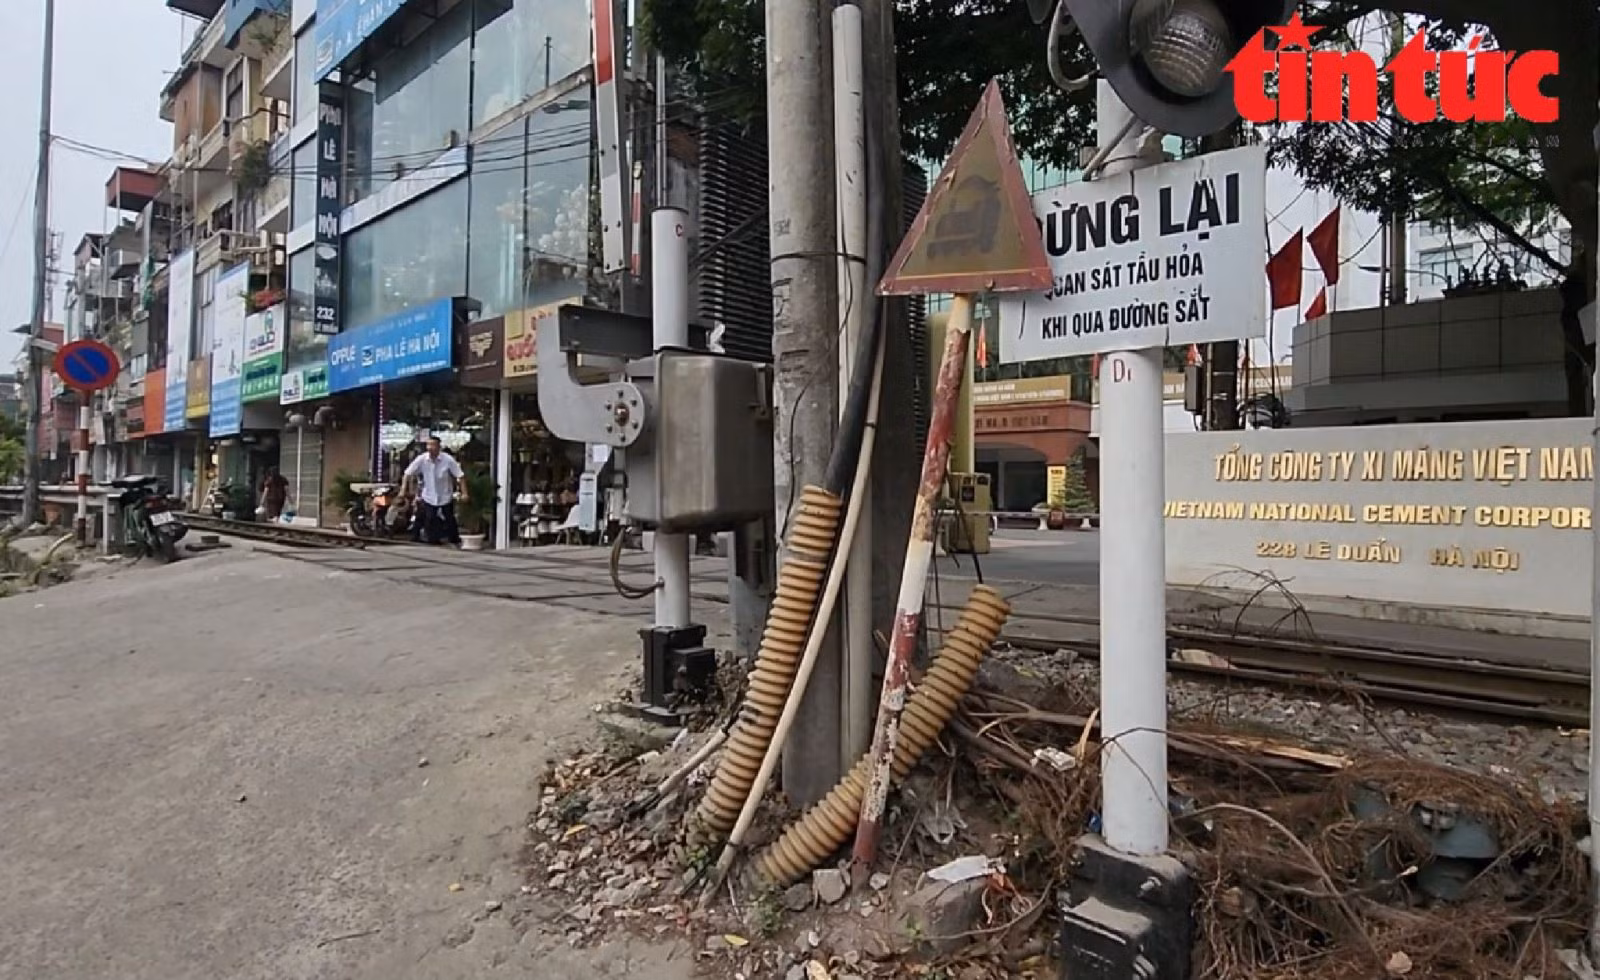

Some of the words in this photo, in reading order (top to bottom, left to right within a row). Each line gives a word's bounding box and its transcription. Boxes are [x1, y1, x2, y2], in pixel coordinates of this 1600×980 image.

[324, 138, 337, 161] LÊ
[1034, 194, 1139, 257] ỪNG
[1160, 173, 1239, 240] LẠI
[1045, 270, 1086, 301] UAN
[1091, 261, 1122, 291] SÁT
[1166, 243, 1203, 279] HỎA
[317, 306, 334, 320] 232
[1042, 315, 1068, 340] KHI
[1072, 310, 1104, 338] QUA
[1109, 297, 1168, 331] ĐƯỜNG
[1175, 285, 1210, 323] SẮT
[394, 336, 406, 358] LÊ
[1215, 443, 1263, 481] TỔNG
[1269, 448, 1322, 481] CÔNG
[1328, 452, 1355, 481] TY
[1361, 450, 1385, 481] XI
[1472, 445, 1531, 487] VIỆT
[1249, 502, 1356, 523] NATIONAL
[1362, 504, 1467, 526] CEMENT
[1256, 541, 1297, 558] 228
[1303, 540, 1331, 560] LÊ
[1429, 544, 1464, 566] HÀ
[1472, 546, 1519, 574] NỘI
